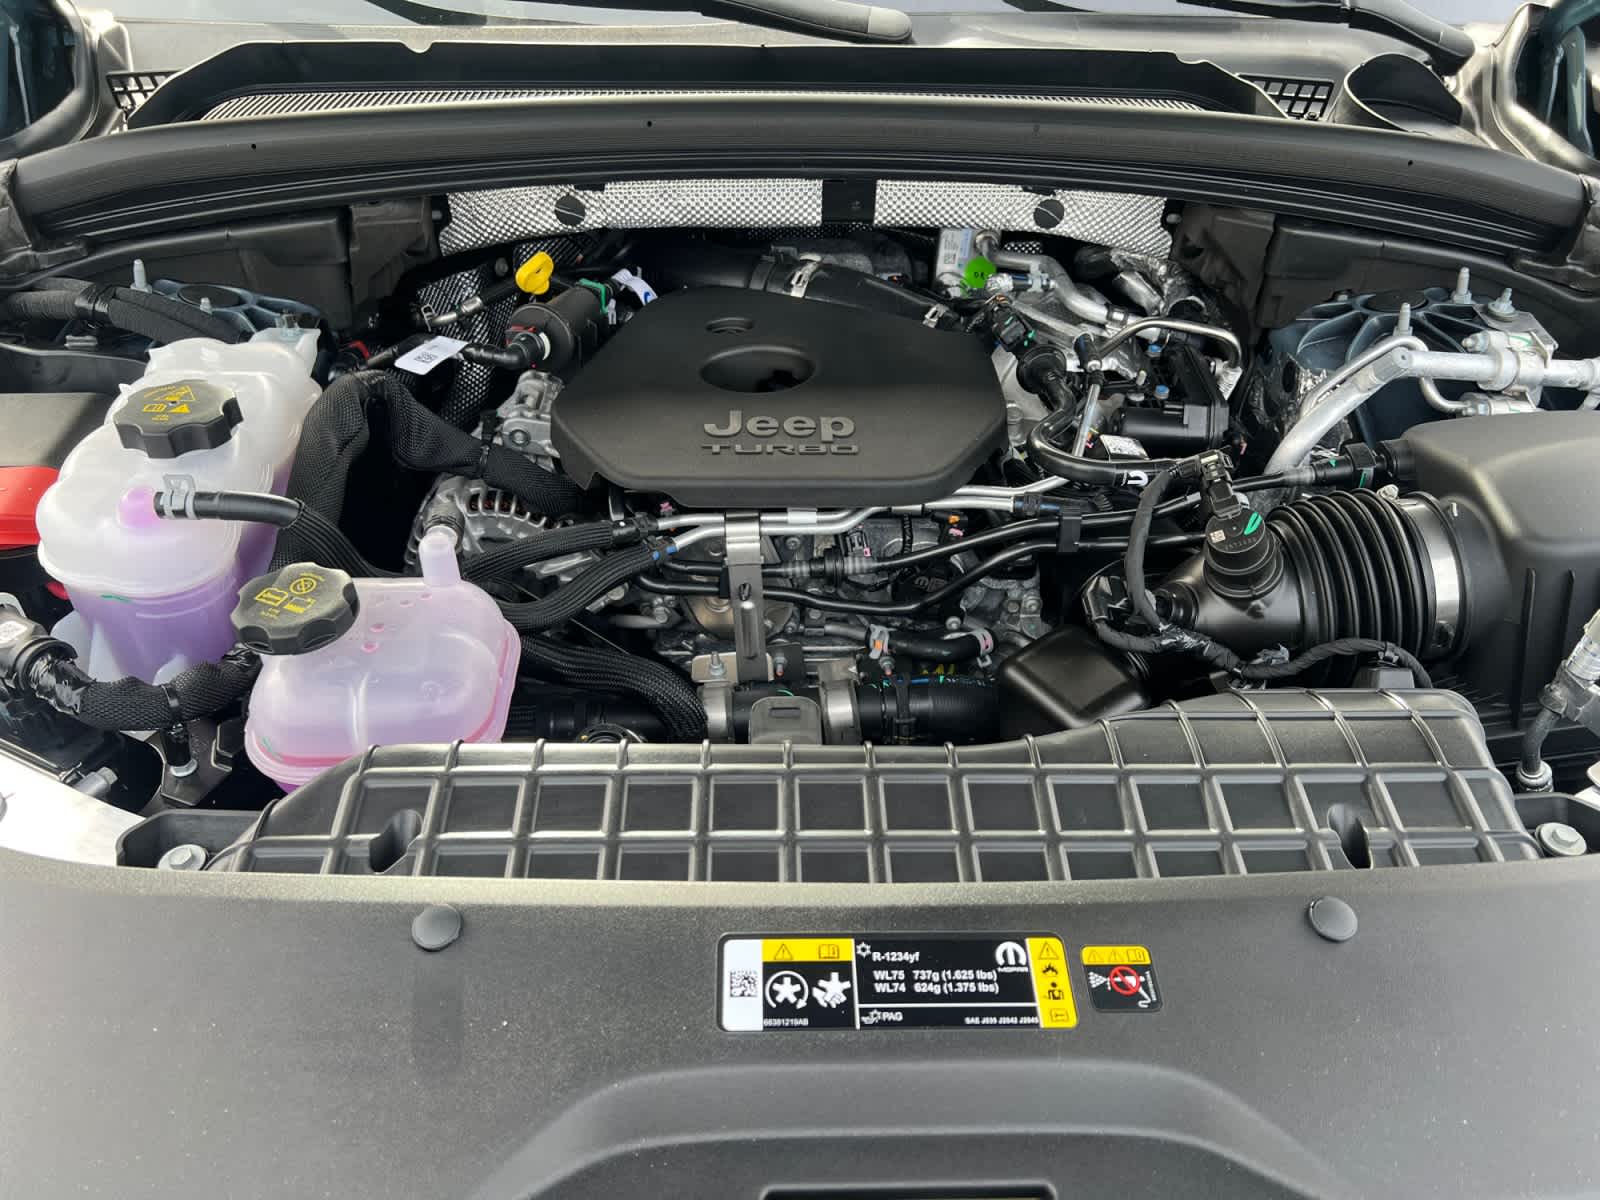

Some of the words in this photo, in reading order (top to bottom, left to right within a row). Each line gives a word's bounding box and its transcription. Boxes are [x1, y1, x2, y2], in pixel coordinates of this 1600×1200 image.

[703, 410, 856, 443] Jeep
[701, 444, 859, 456] TURBO
[872, 951, 920, 963] R-1234yf
[873, 970, 905, 981] WL75
[912, 970, 940, 982] 737g
[941, 970, 975, 983] (1.625
[976, 969, 998, 981] lbs)
[874, 982, 906, 993] WL74
[913, 982, 941, 995] 624g
[943, 982, 976, 994] (1.375
[978, 982, 1000, 995] lbs)
[881, 1011, 904, 1022] PAG
